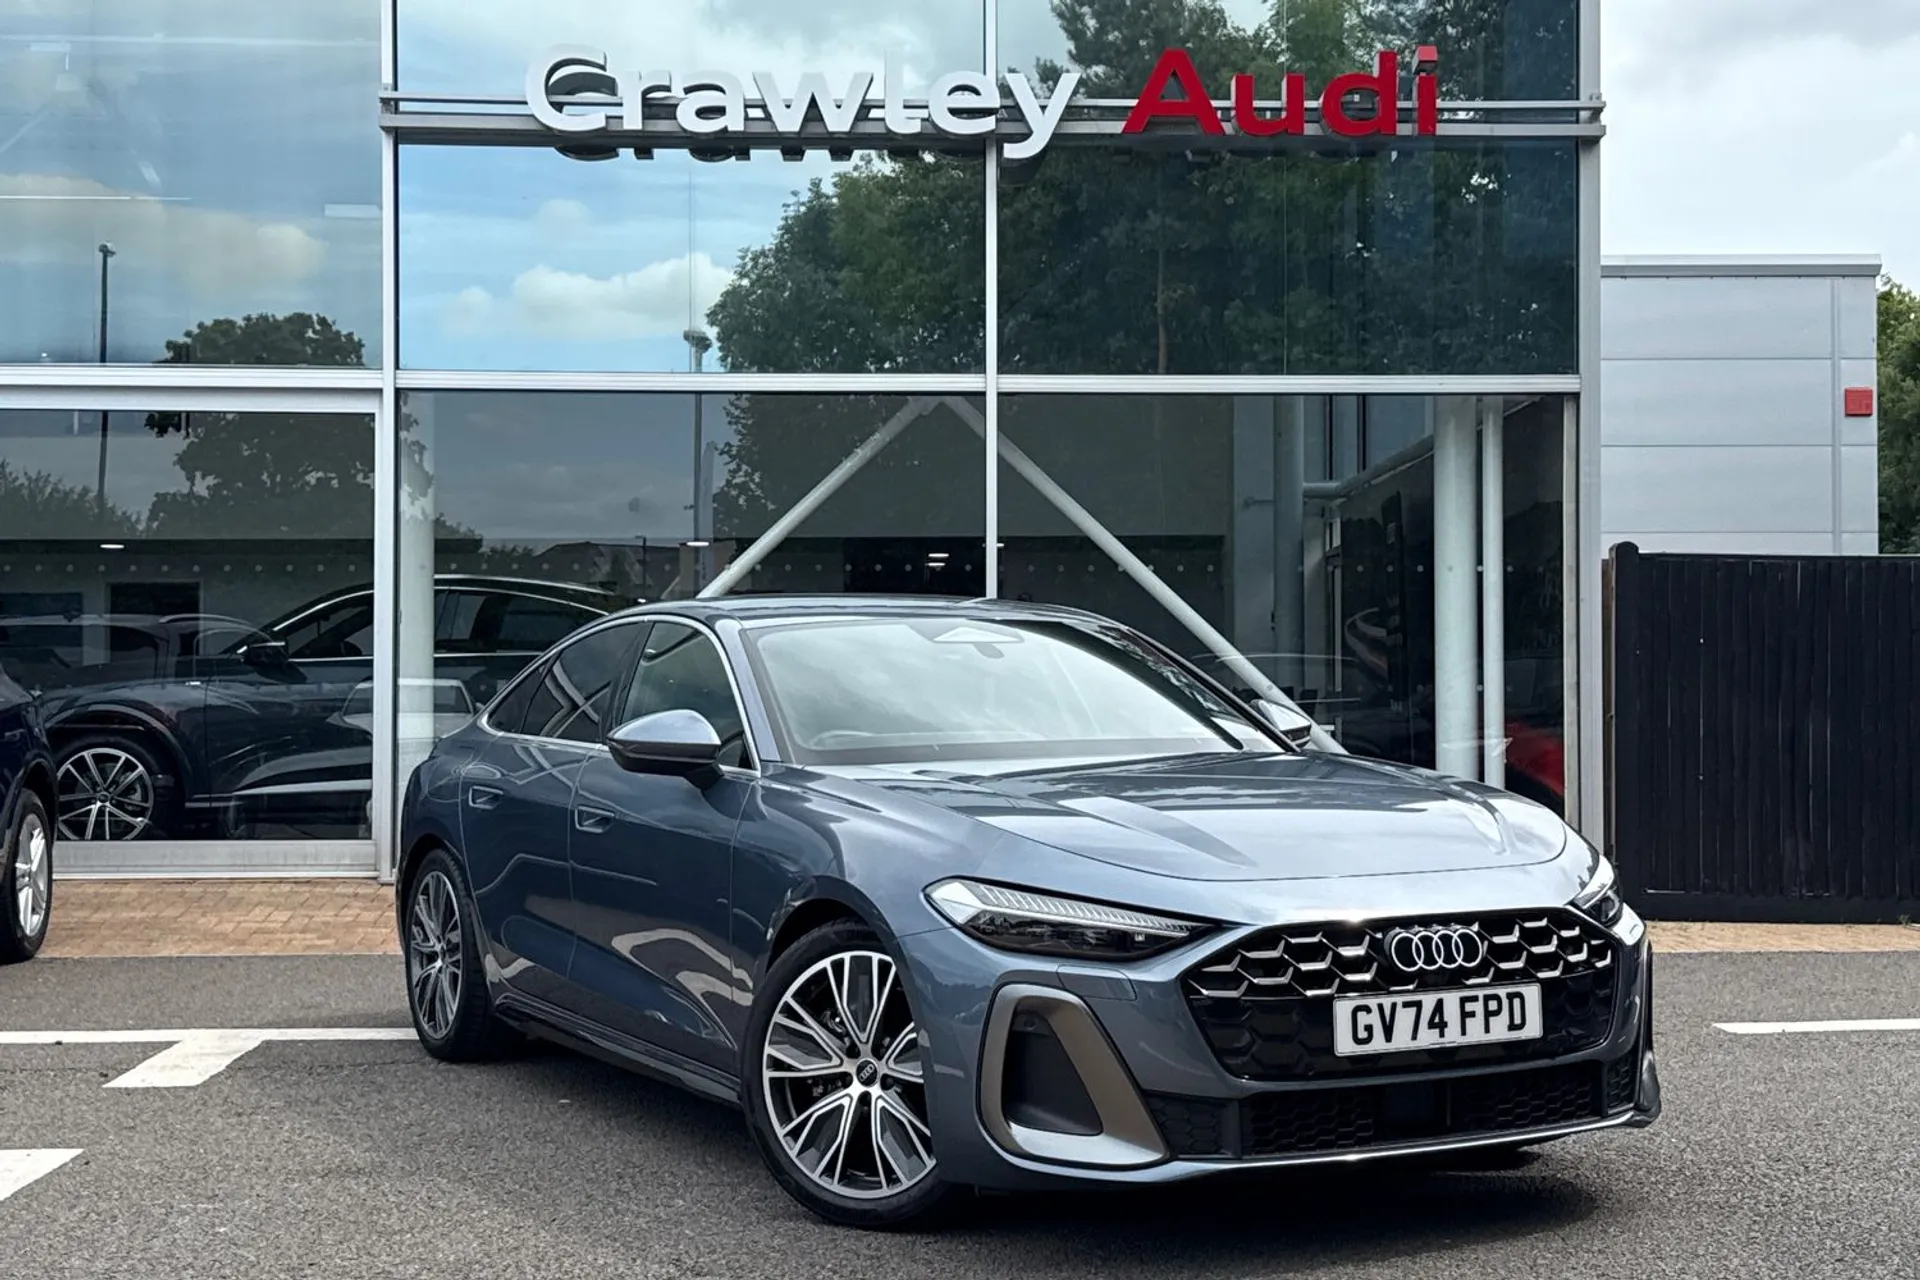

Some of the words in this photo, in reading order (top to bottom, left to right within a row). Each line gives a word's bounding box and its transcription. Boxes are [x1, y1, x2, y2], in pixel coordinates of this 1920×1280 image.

[526, 45, 1080, 159] Crawley
[1123, 46, 1437, 136] Audi
[1351, 998, 1448, 1045] GV74
[1460, 992, 1526, 1036] FPD
